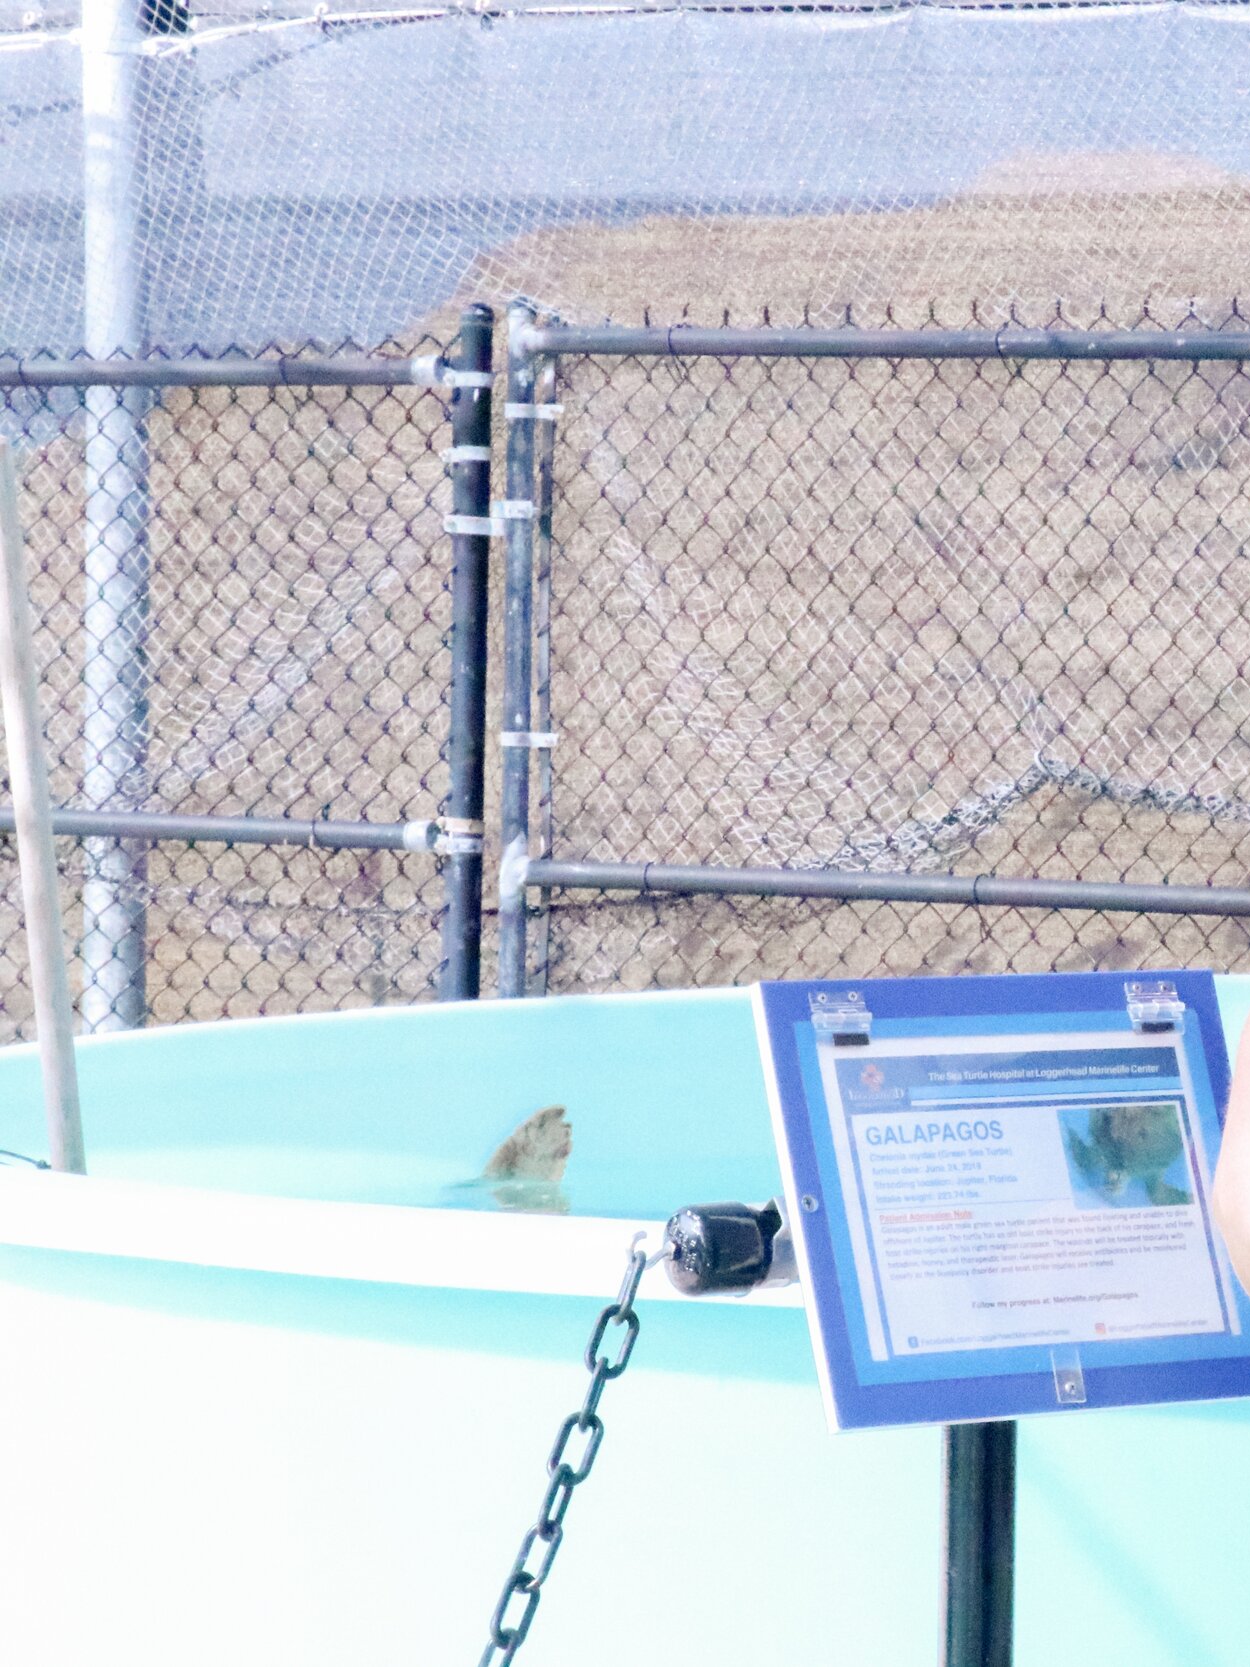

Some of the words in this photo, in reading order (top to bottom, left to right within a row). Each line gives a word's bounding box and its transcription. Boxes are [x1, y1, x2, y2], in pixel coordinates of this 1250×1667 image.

[989, 1068, 1025, 1079] Hospital
[1130, 1064, 1160, 1072] Center
[865, 1121, 1003, 1145] GALAPAGOS
